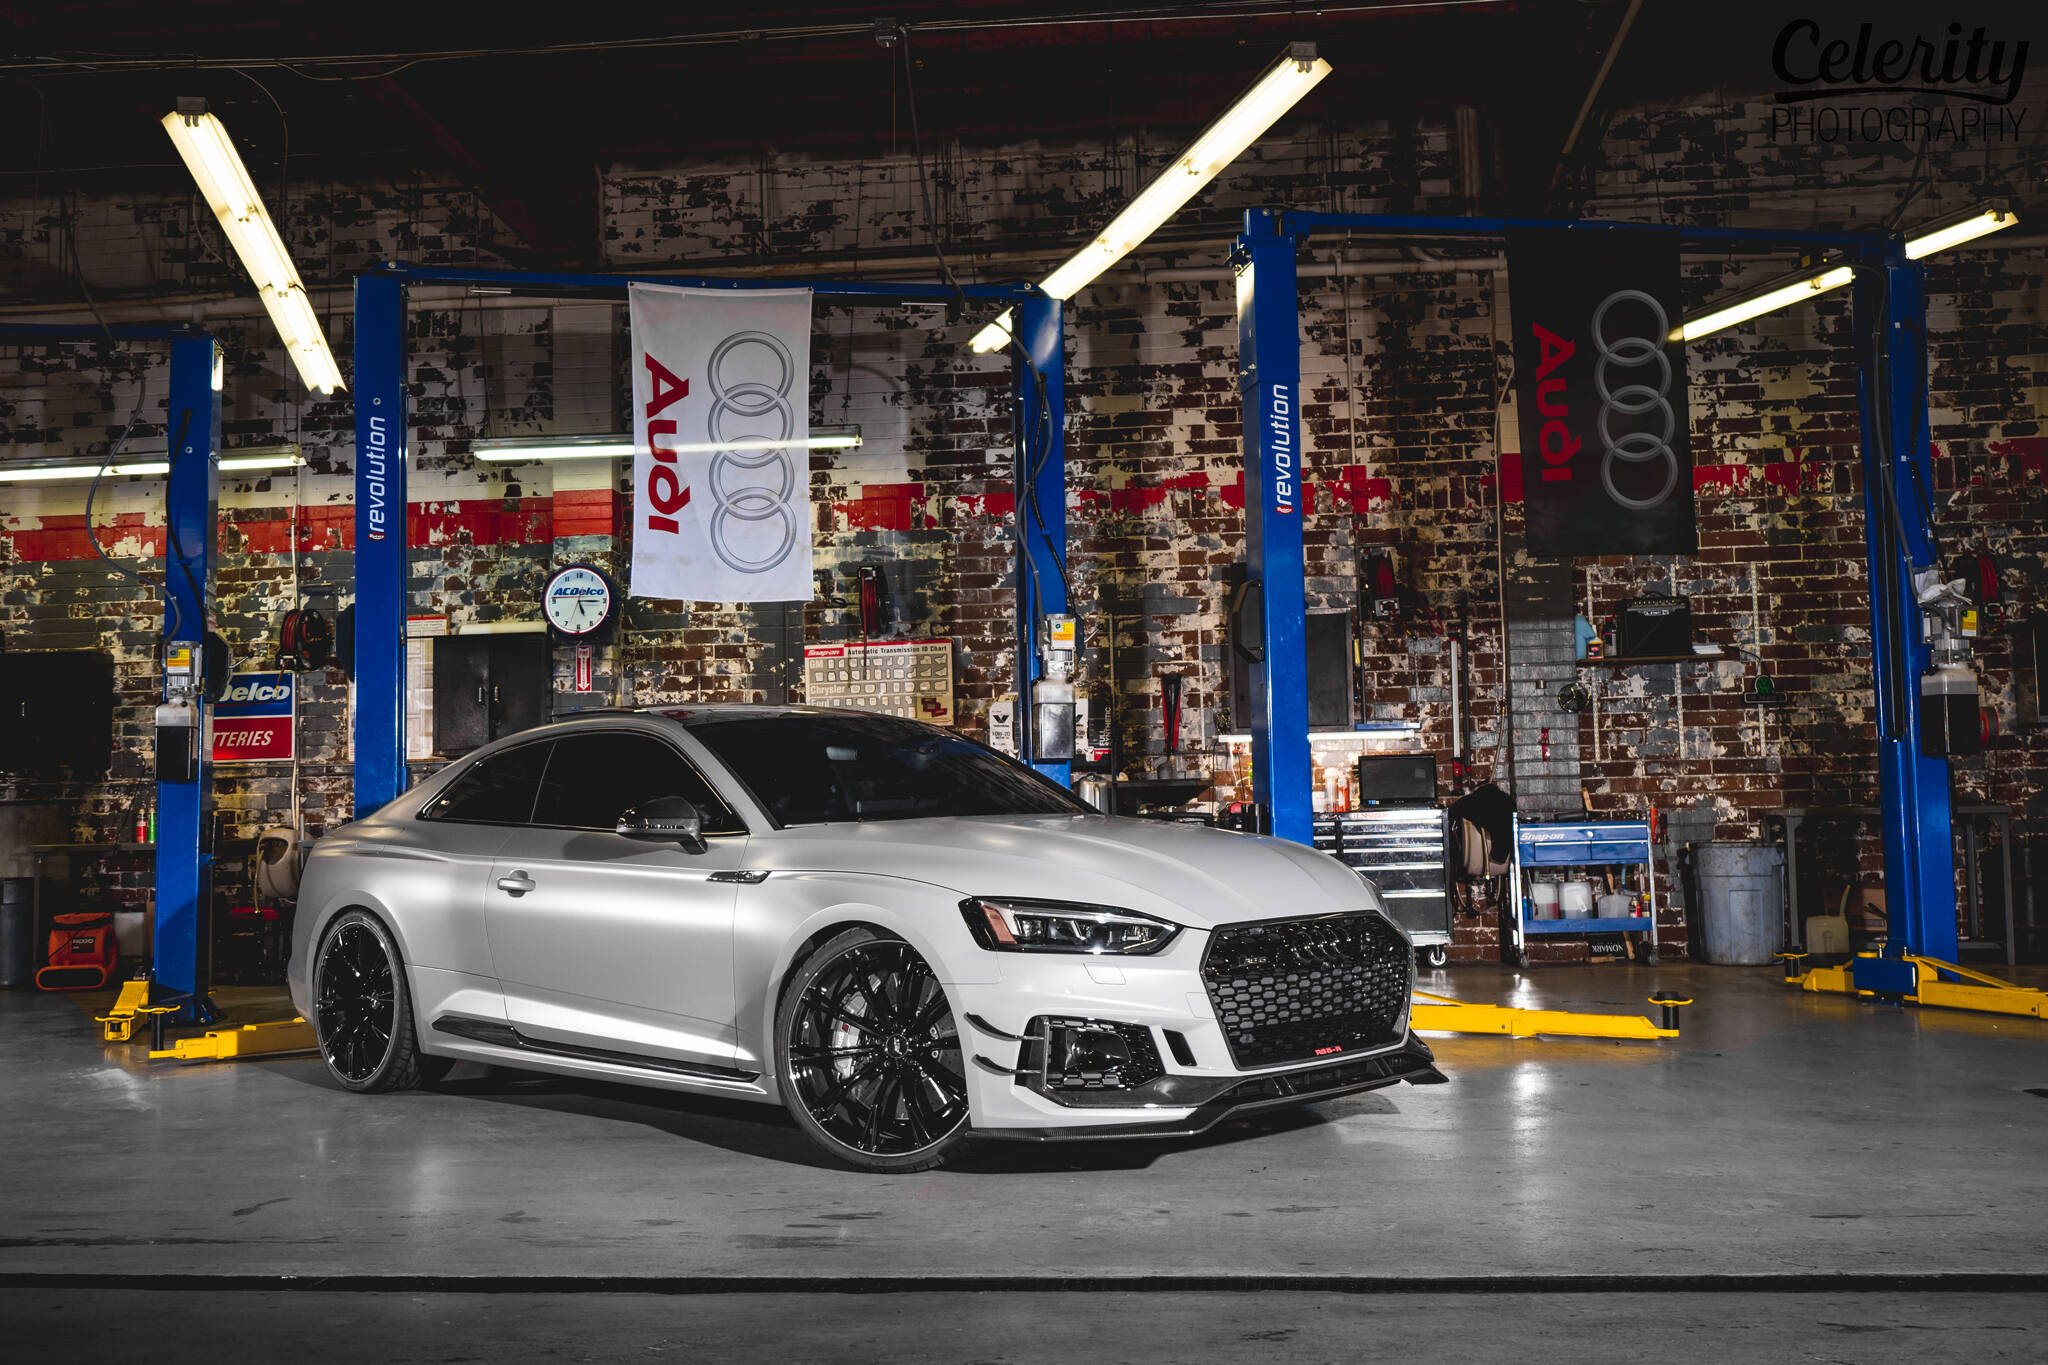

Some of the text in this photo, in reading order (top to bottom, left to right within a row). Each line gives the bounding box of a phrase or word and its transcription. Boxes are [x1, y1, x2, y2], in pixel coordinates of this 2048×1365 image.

[1532, 321, 1582, 482] Audi
[366, 416, 386, 533] revolution
[645, 352, 691, 535] Audi
[1270, 384, 1292, 505] revolution
[554, 587, 604, 595] ACDelco
[807, 649, 841, 657] Snap-on
[810, 686, 845, 696] Chrysler
[1520, 832, 1565, 841] Snap-on
